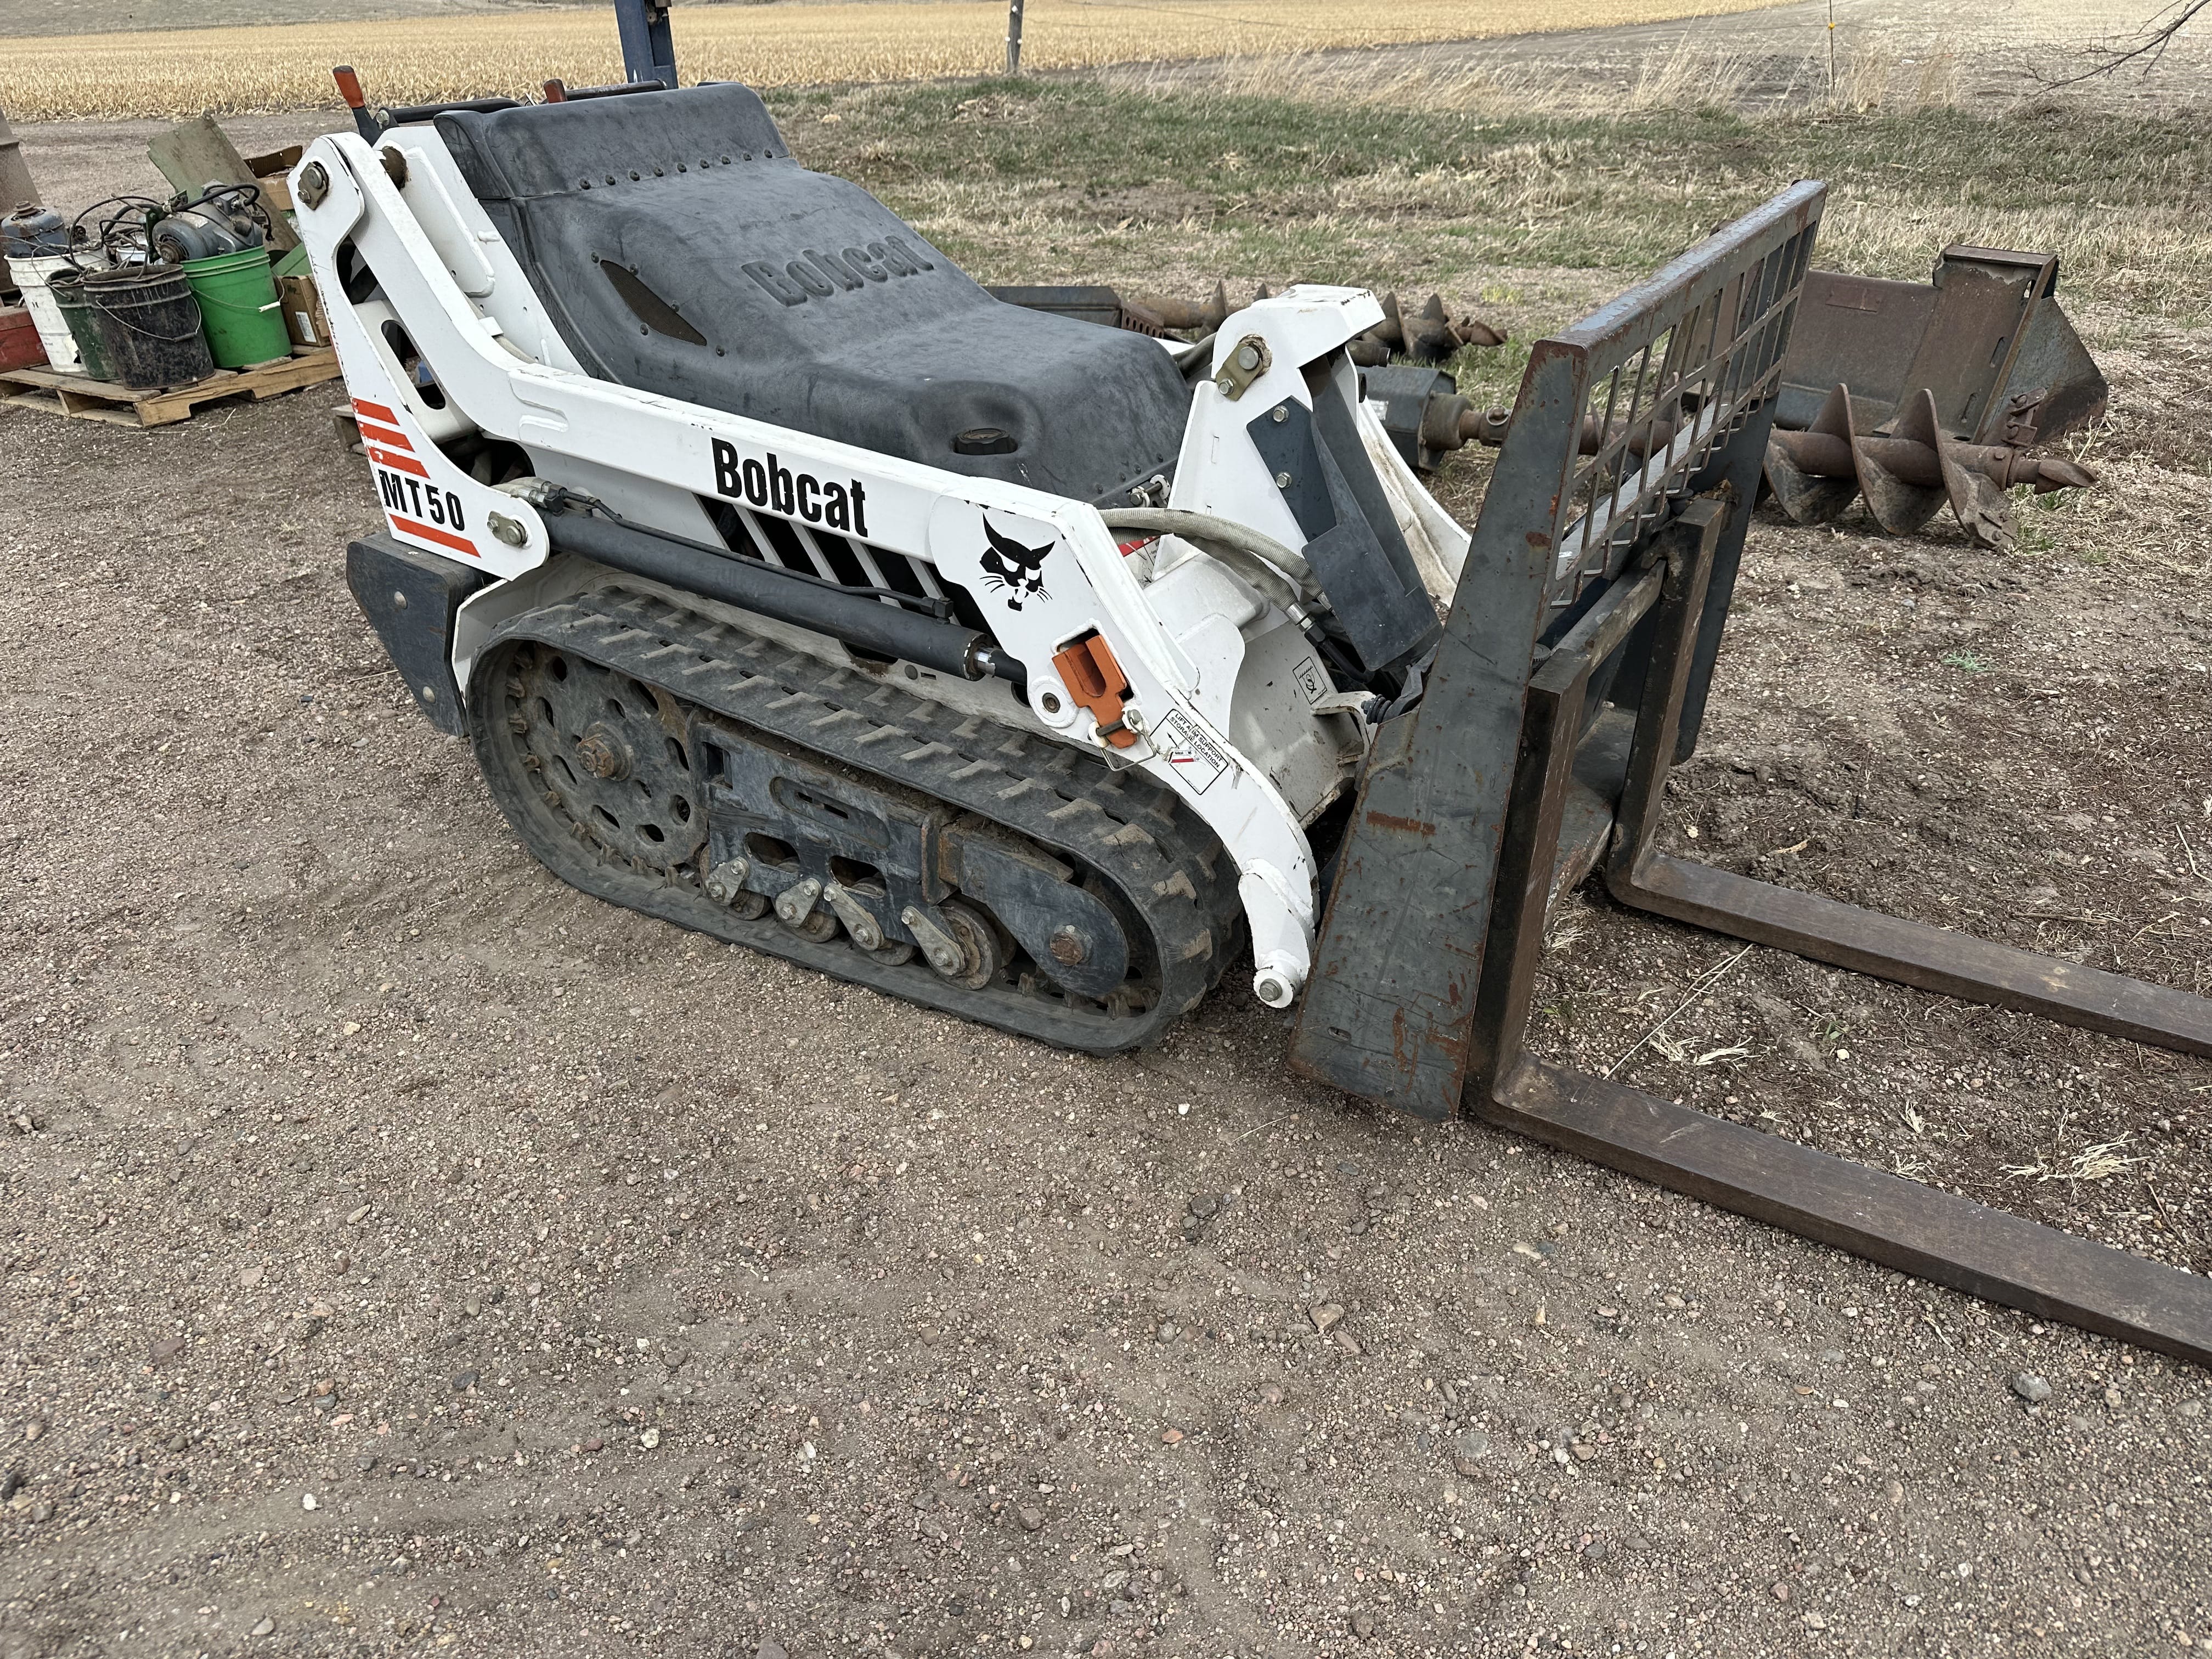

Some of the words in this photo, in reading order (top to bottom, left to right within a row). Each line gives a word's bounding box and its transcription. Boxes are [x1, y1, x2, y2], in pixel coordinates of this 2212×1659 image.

[741, 235, 934, 307] Bobcat
[377, 469, 465, 531] MT50
[711, 437, 868, 538] Bobcat
[1175, 713, 1187, 725] LIFT
[1198, 737, 1223, 761] SUPPORT
[1194, 741, 1220, 768] LOCATION
